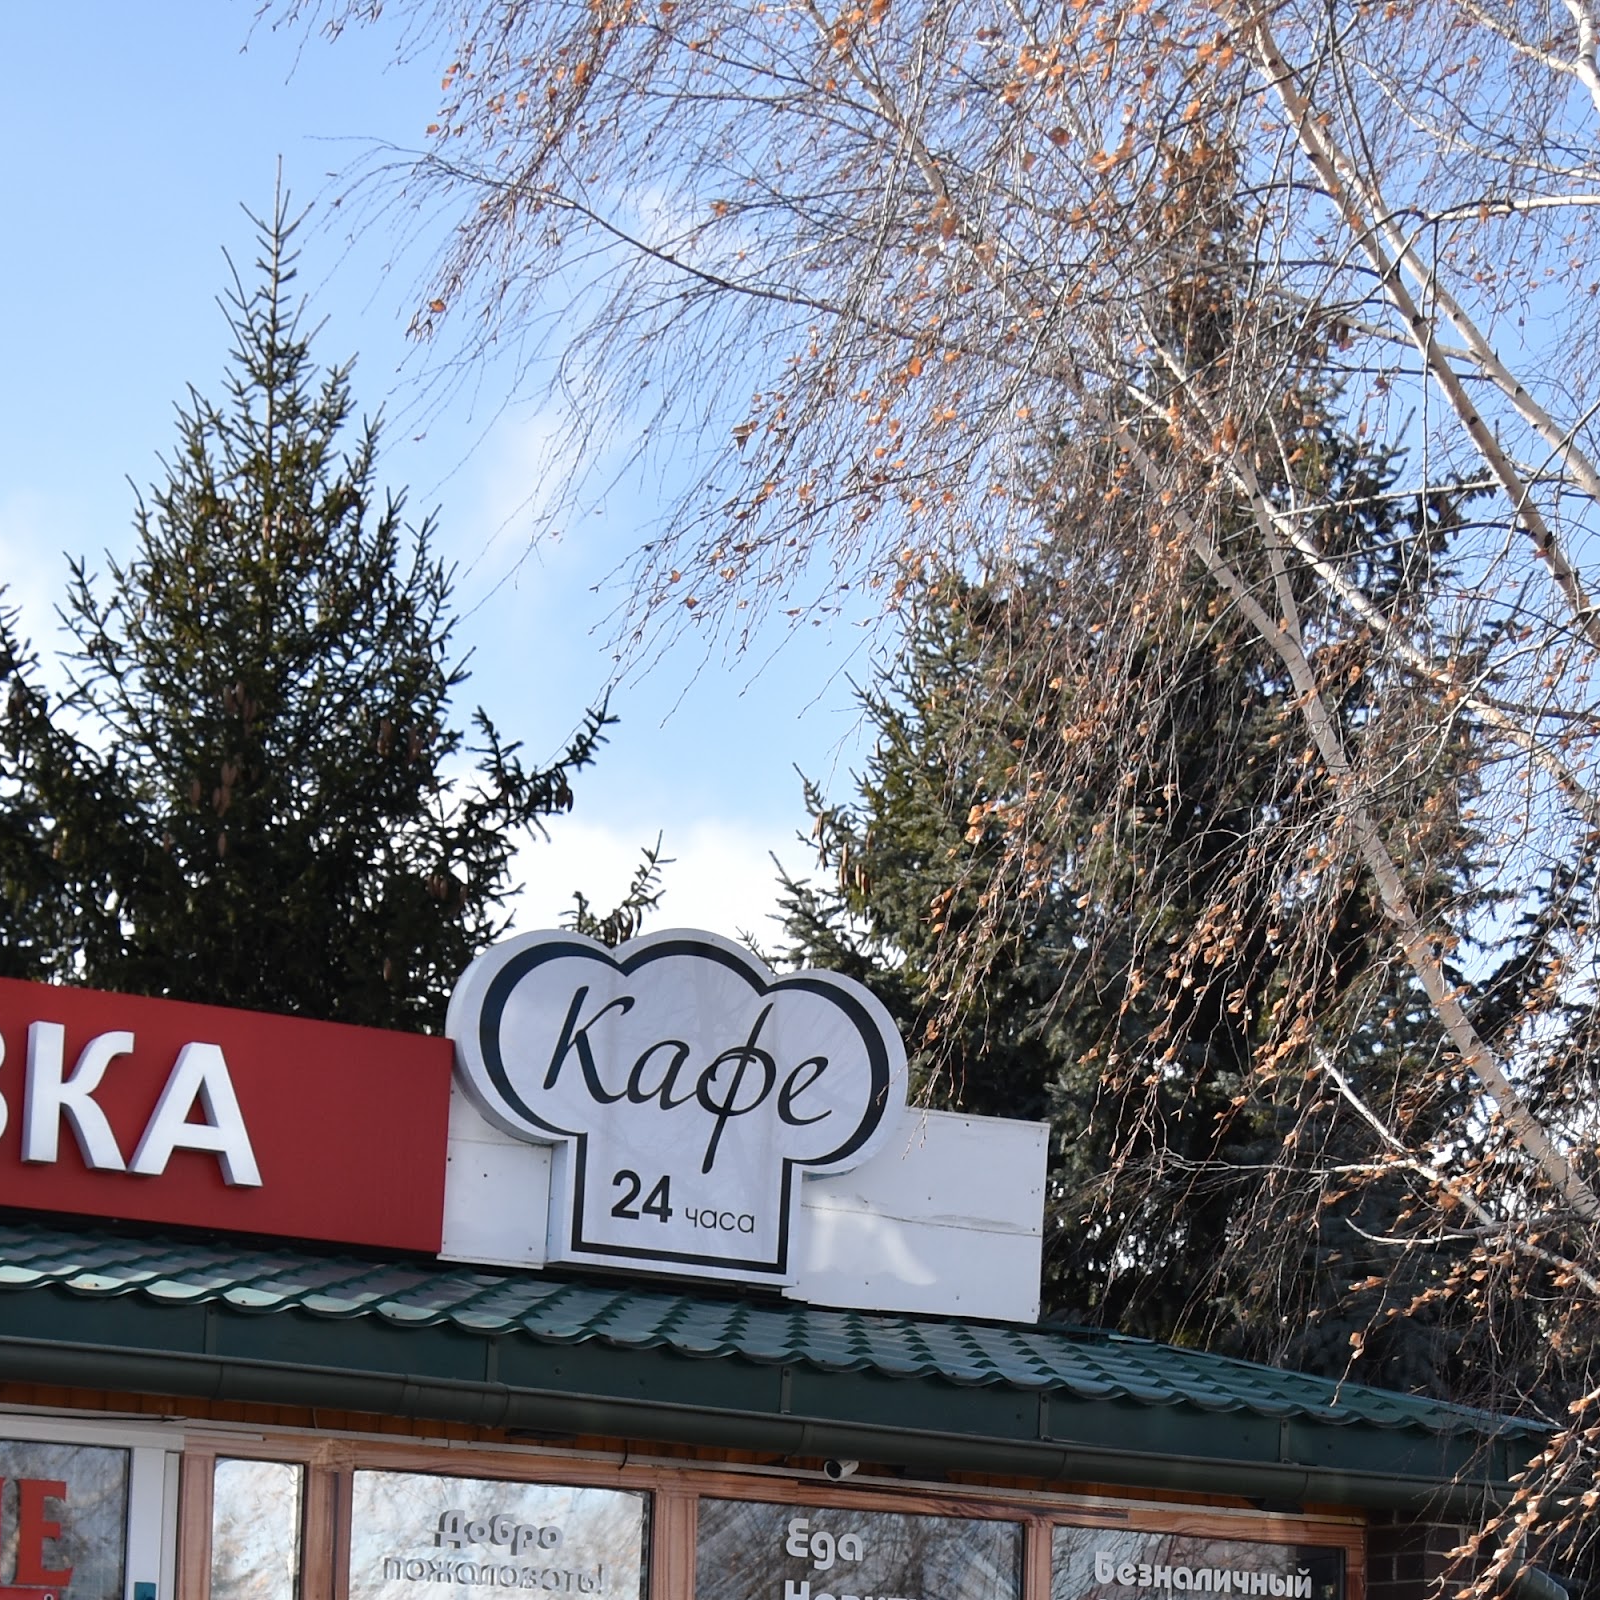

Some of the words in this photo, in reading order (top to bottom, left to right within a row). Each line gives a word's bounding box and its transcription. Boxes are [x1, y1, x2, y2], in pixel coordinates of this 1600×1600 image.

[544, 986, 833, 1175] Кафе
[610, 1169, 674, 1224] 24
[684, 1204, 756, 1235] часа
[434, 1509, 564, 1556] Добро
[786, 1517, 864, 1570] Еда
[383, 1556, 610, 1595] пожаловать!
[1094, 1550, 1313, 1599] Безналичный
